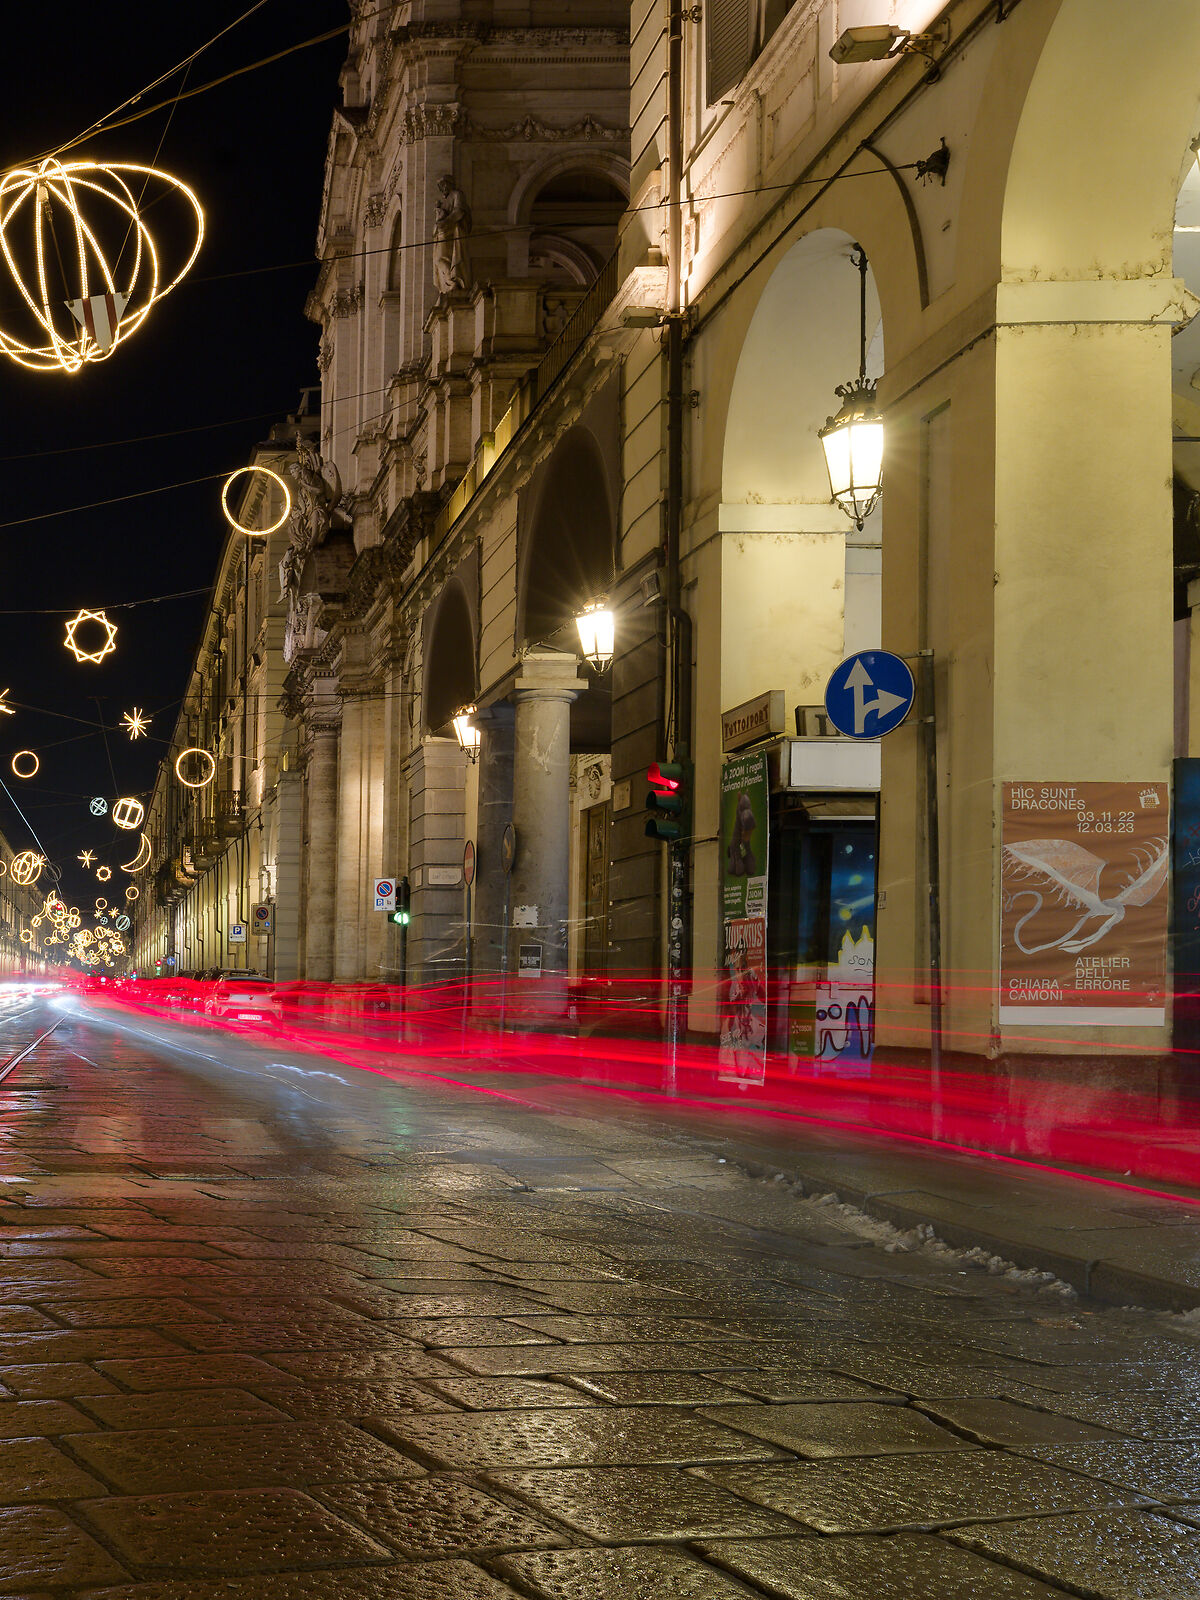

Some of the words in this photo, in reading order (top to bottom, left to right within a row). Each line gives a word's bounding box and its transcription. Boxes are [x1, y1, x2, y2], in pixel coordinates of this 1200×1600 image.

[724, 704, 769, 738] TUTTOSPORT
[723, 769, 728, 780] A
[729, 765, 745, 779] ZOOM
[1011, 787, 1034, 799] HIC
[1040, 788, 1077, 799] SUNT
[1011, 799, 1086, 810] DRACONES
[1077, 811, 1135, 822] 03.11.22
[1076, 822, 1135, 833] 12.03.23
[725, 922, 763, 949] JUVENTUS
[1074, 957, 1130, 968] ATELIER
[1075, 968, 1112, 979] DELL'
[1009, 979, 1060, 990] CHIARA
[1075, 979, 1130, 990] ERRORE
[1009, 990, 1063, 1001] CAMONI
